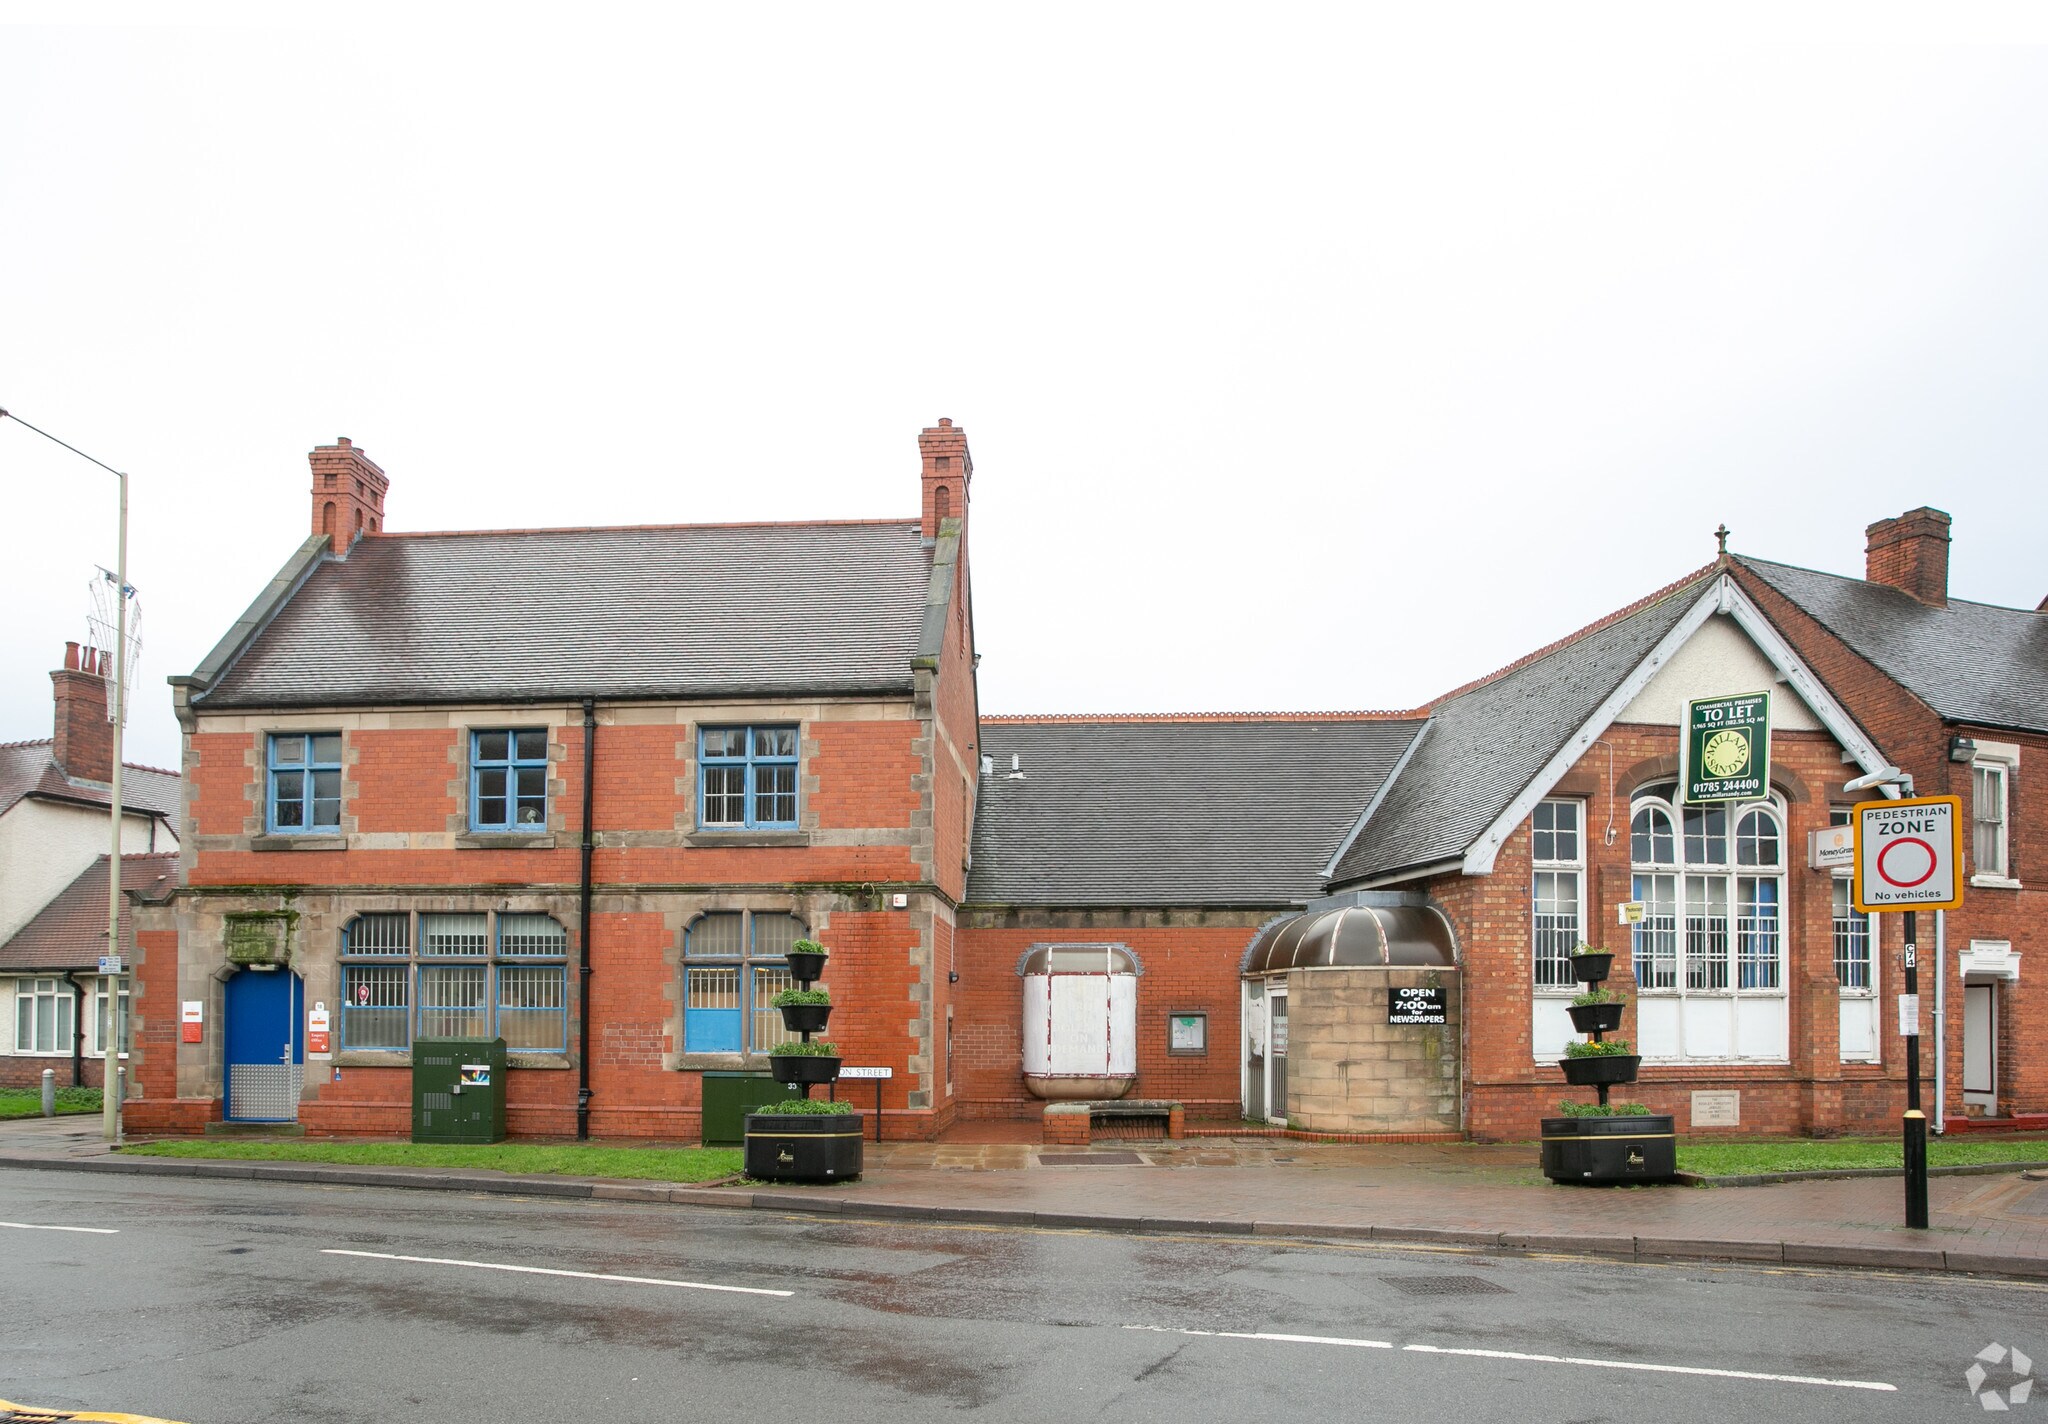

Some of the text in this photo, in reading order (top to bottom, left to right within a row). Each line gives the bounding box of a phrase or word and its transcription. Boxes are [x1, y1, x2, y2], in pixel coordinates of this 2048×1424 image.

[1696, 701, 1733, 711] COMMERCIAL
[1703, 705, 1754, 722] TO LET
[1707, 733, 1746, 755] MILLAR
[1709, 759, 1743, 774] SANDY
[1693, 779, 1759, 793] 01785 244400
[1698, 791, 1752, 799] www.millarsandy.com
[1867, 807, 1947, 820] PEDESTRIAN
[1879, 820, 1935, 835] ZONE
[1875, 890, 1941, 900] No vehicles
[1907, 945, 1915, 966] C74
[1400, 988, 1435, 997] OPEN
[1394, 1001, 1441, 1010] 7:00am
[1390, 1015, 1445, 1023] NEWSPAPERS
[856, 1068, 890, 1076] STREET
